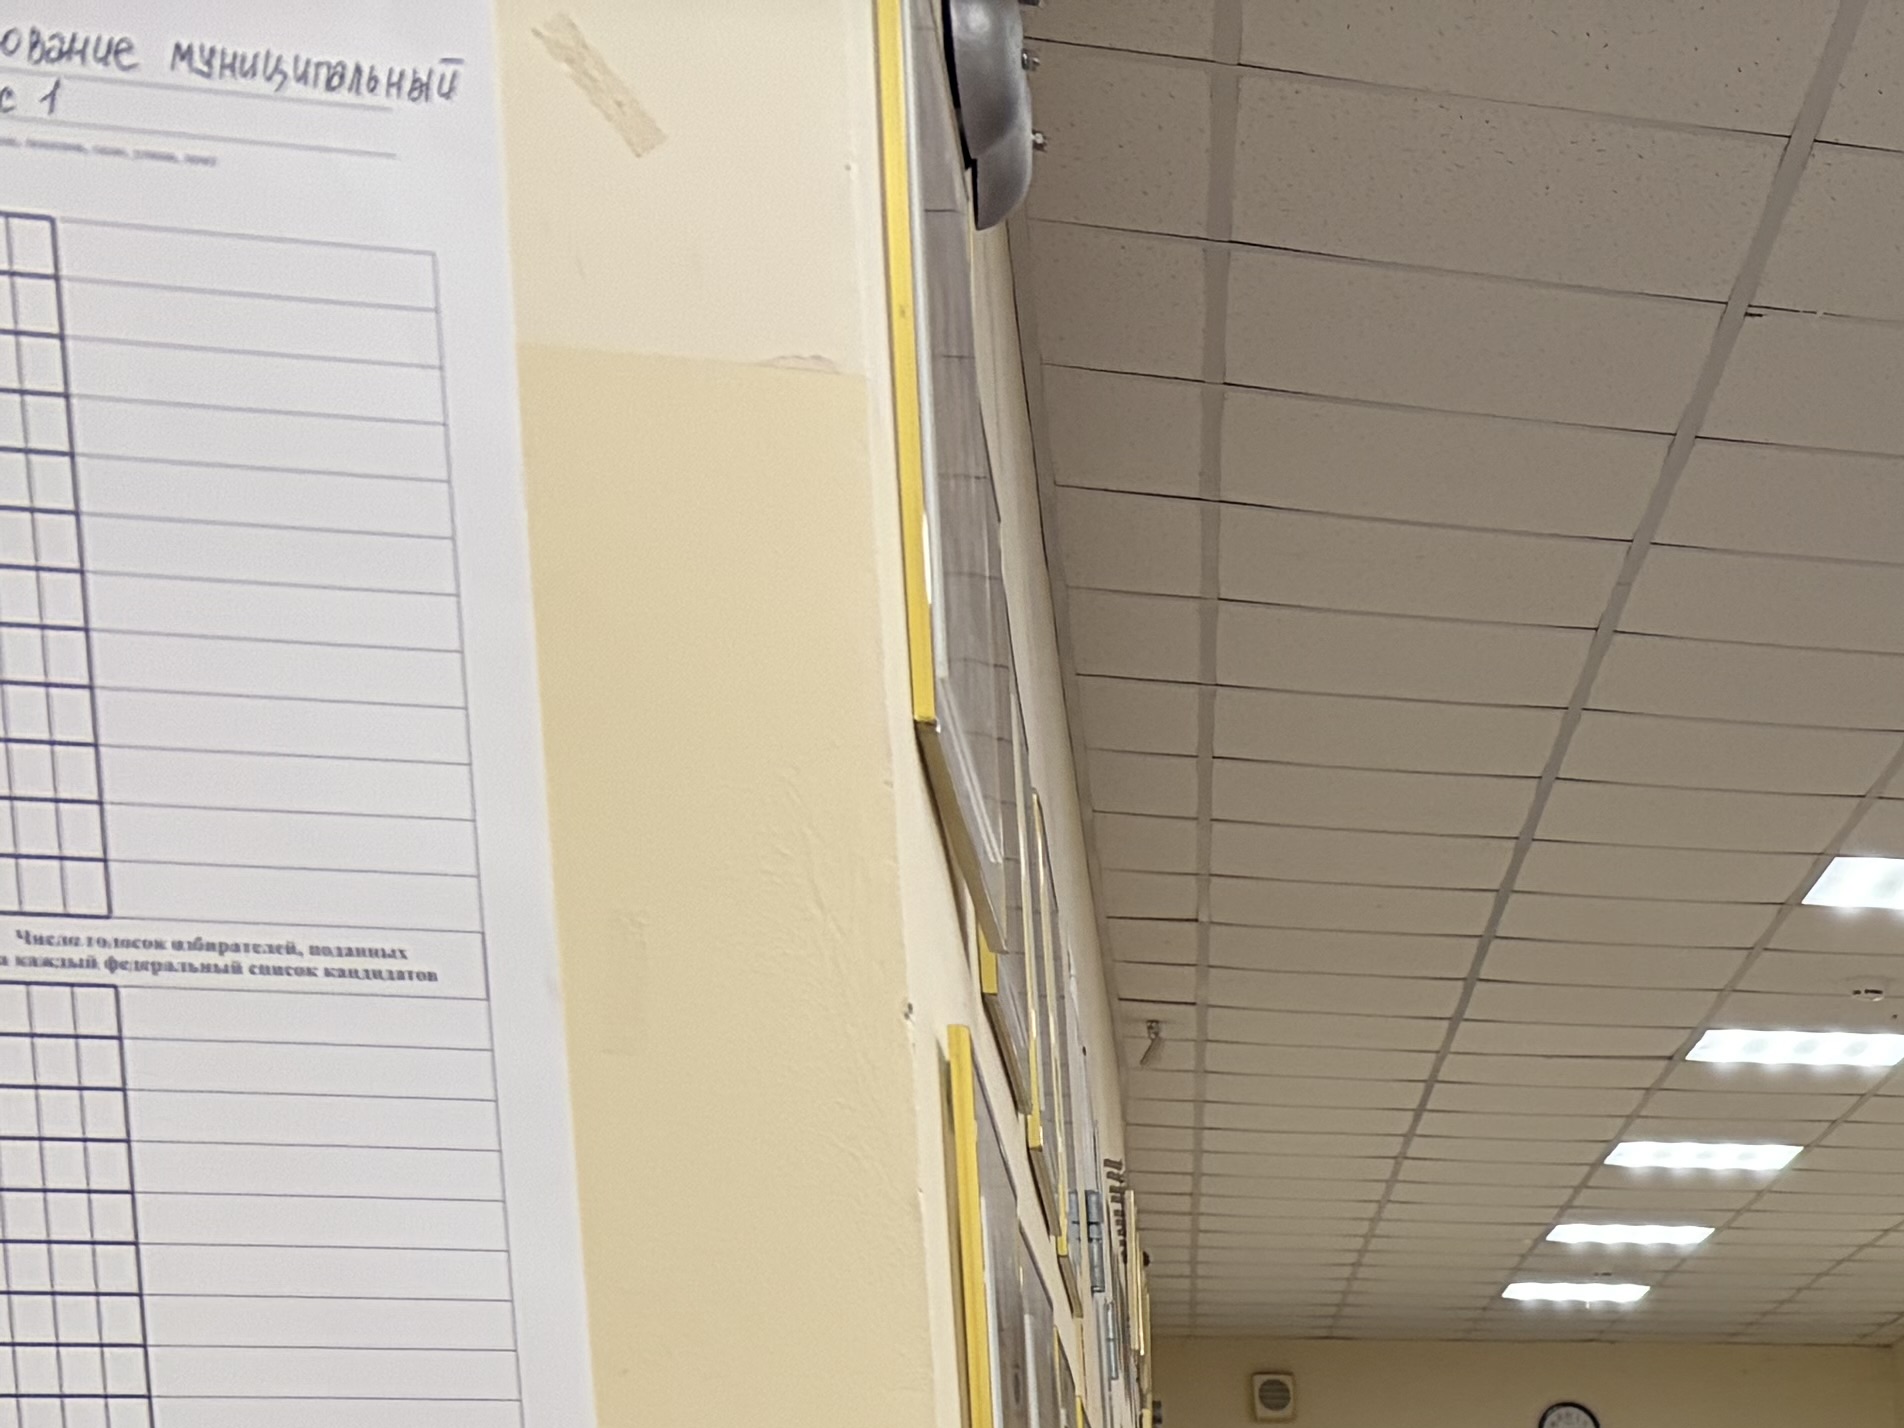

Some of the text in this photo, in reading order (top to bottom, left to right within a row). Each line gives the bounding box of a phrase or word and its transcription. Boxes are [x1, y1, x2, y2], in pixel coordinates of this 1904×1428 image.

[171, 39, 466, 102] муниципальный
[40, 76, 60, 115] 1
[104, 955, 244, 976] федеральный
[249, 963, 318, 978] список
[324, 967, 439, 982] кандидатов
